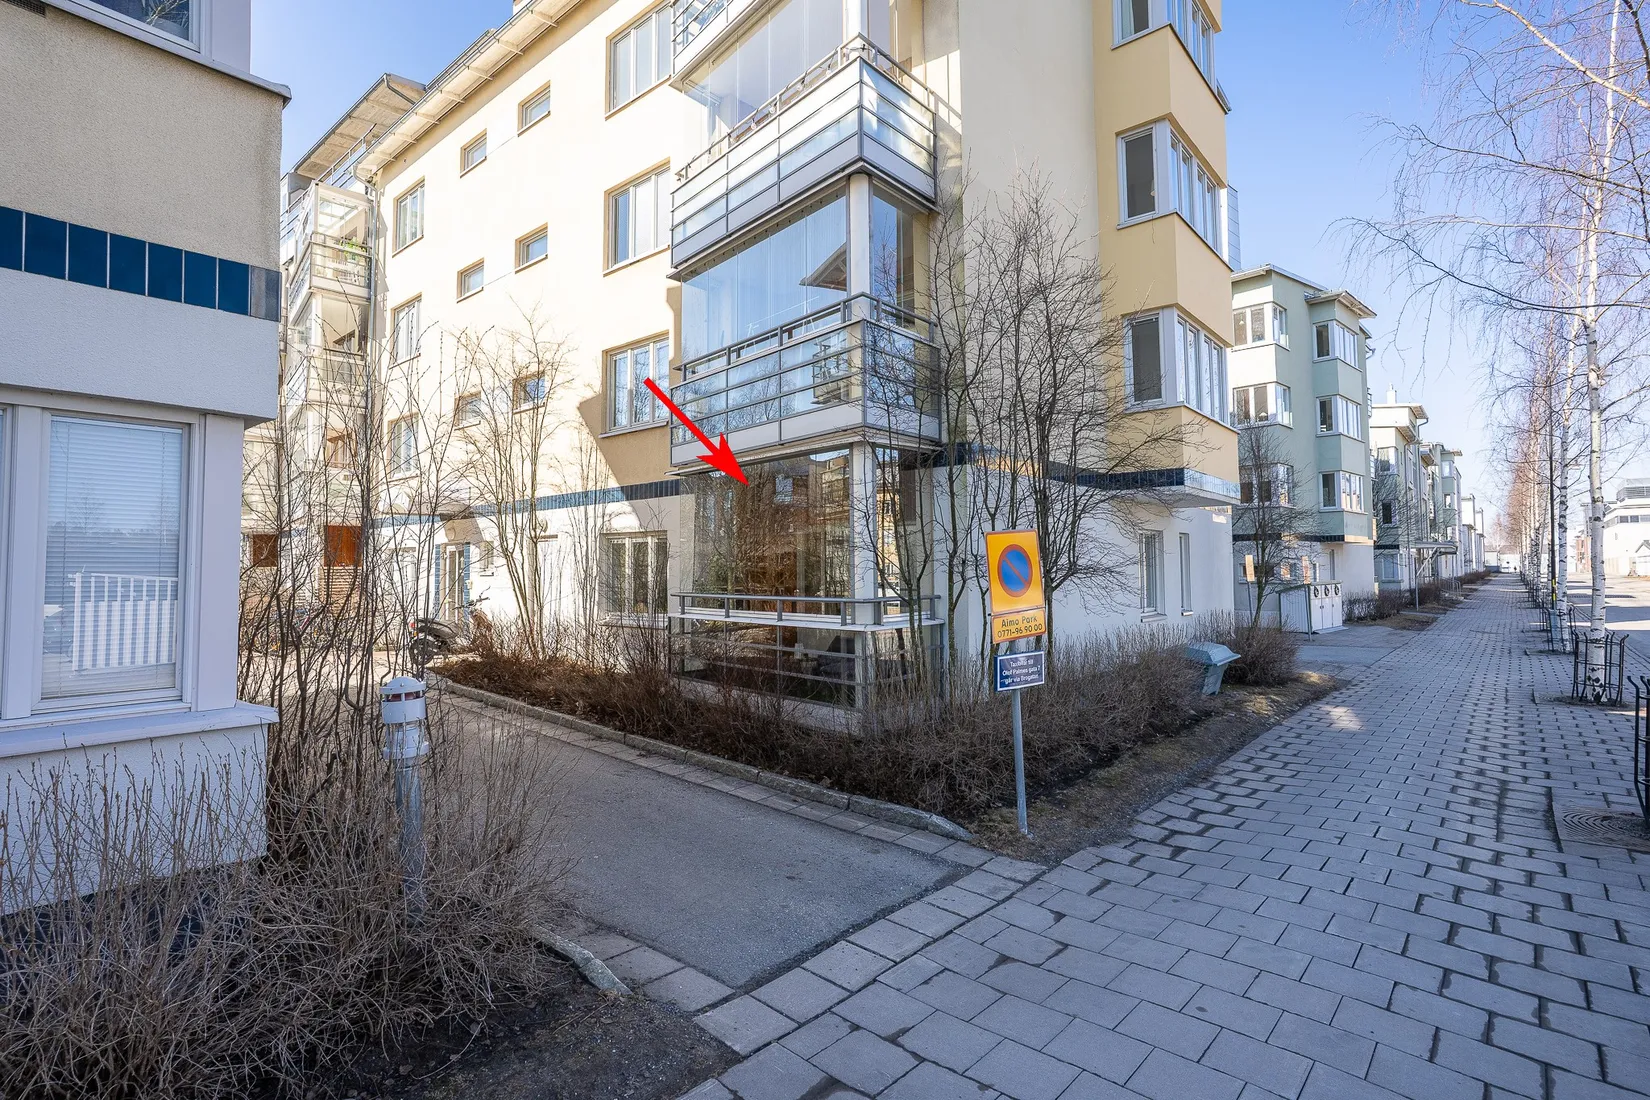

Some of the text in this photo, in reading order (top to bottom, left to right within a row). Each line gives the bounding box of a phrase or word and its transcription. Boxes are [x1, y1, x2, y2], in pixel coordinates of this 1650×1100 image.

[1001, 615, 1038, 628] Aimo Park
[997, 623, 1042, 638] 0771-96 90 00
